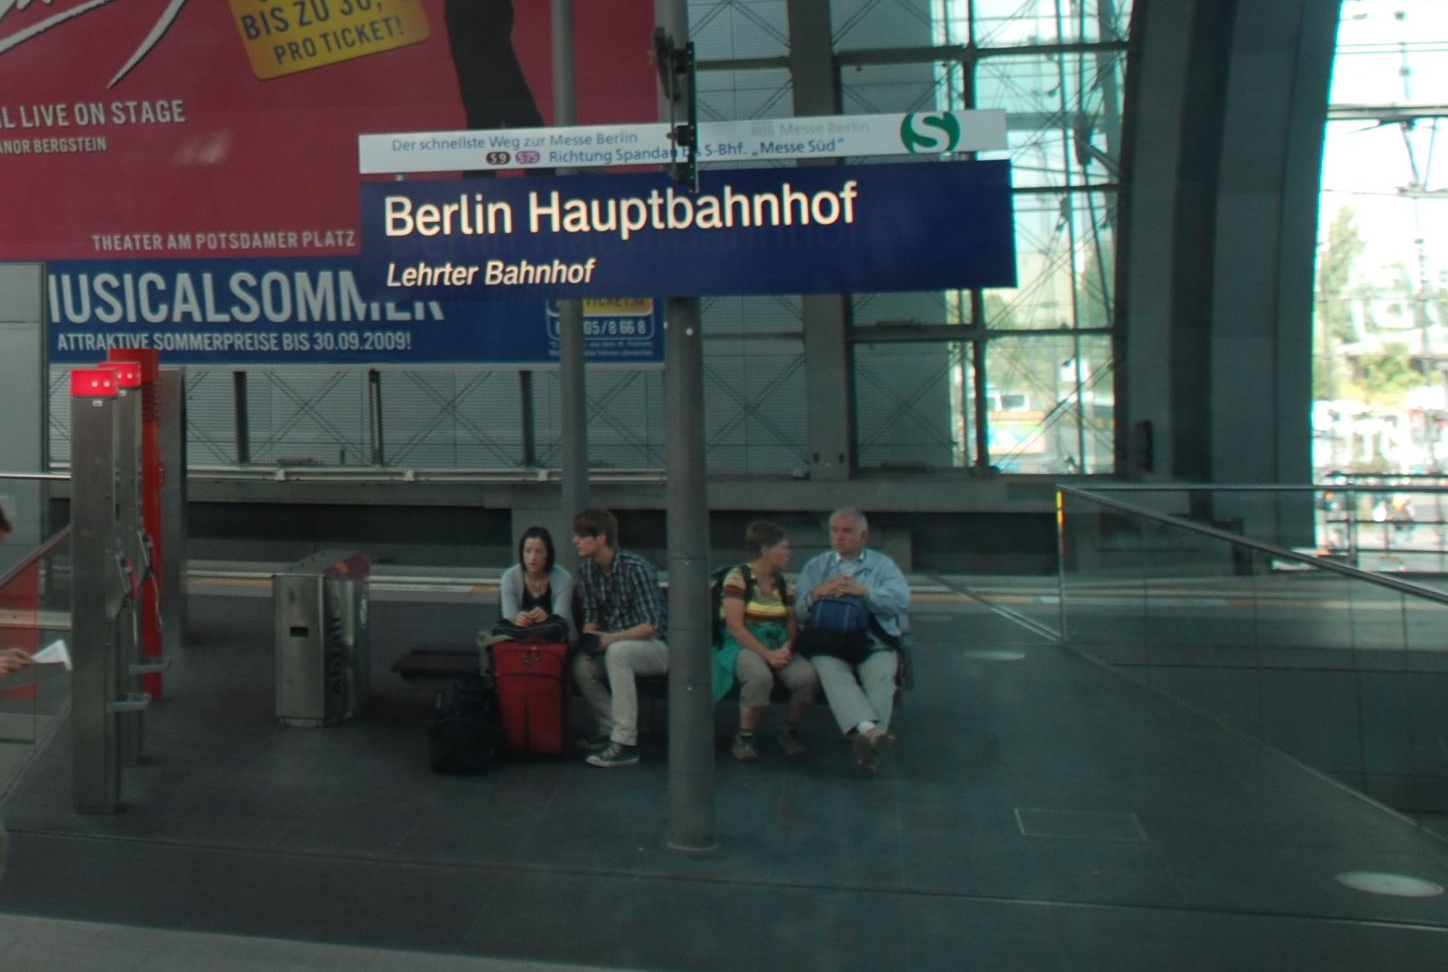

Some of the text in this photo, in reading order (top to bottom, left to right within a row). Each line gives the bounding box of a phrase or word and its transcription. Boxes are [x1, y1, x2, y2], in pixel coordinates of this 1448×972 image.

[242, 7, 289, 41] BIS
[273, 15, 405, 65] PRO TICKET!
[20, 104, 70, 128] LIVE
[74, 102, 106, 125] ON
[111, 99, 186, 124] STAGE
[33, 137, 107, 152] BERGSTEIN
[392, 132, 638, 152] Der schnellste Weg zur Messe Berlin
[549, 149, 613, 166] Richtung
[384, 181, 858, 241] Berlin Hauptbahnhof
[92, 230, 355, 251] THEATER AM POTSDAMER PLATZ
[387, 257, 596, 287] Lehrter Bahnhof
[57, 331, 412, 351] ATTRAKTIVE SOMMERPREISE BIS 30.09.2009!
